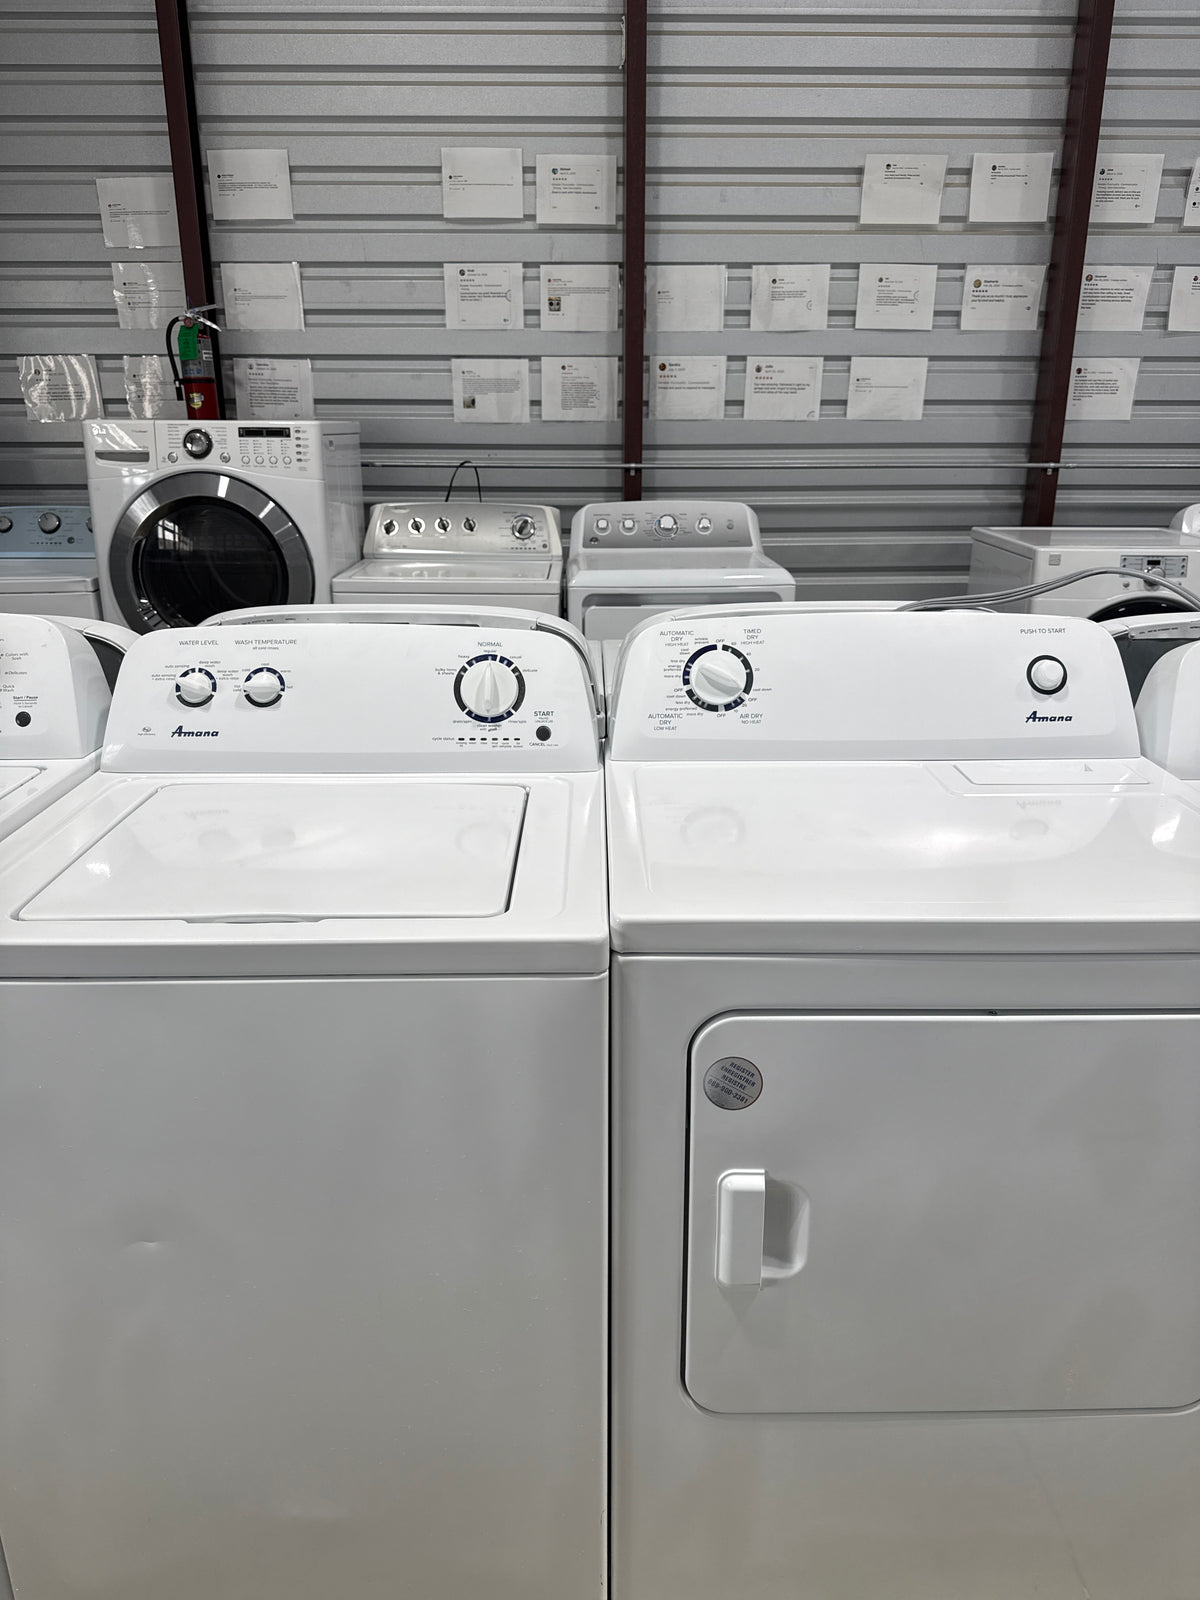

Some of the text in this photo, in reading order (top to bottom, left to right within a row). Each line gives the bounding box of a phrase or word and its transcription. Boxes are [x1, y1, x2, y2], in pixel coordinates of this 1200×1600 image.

[1025, 710, 1073, 723] Amana
[170, 725, 219, 738] Amana
[721, 1066, 756, 1087] ENREGISTRER
[730, 1062, 755, 1078] REGISTER
[721, 1074, 747, 1090] REGISTRE
